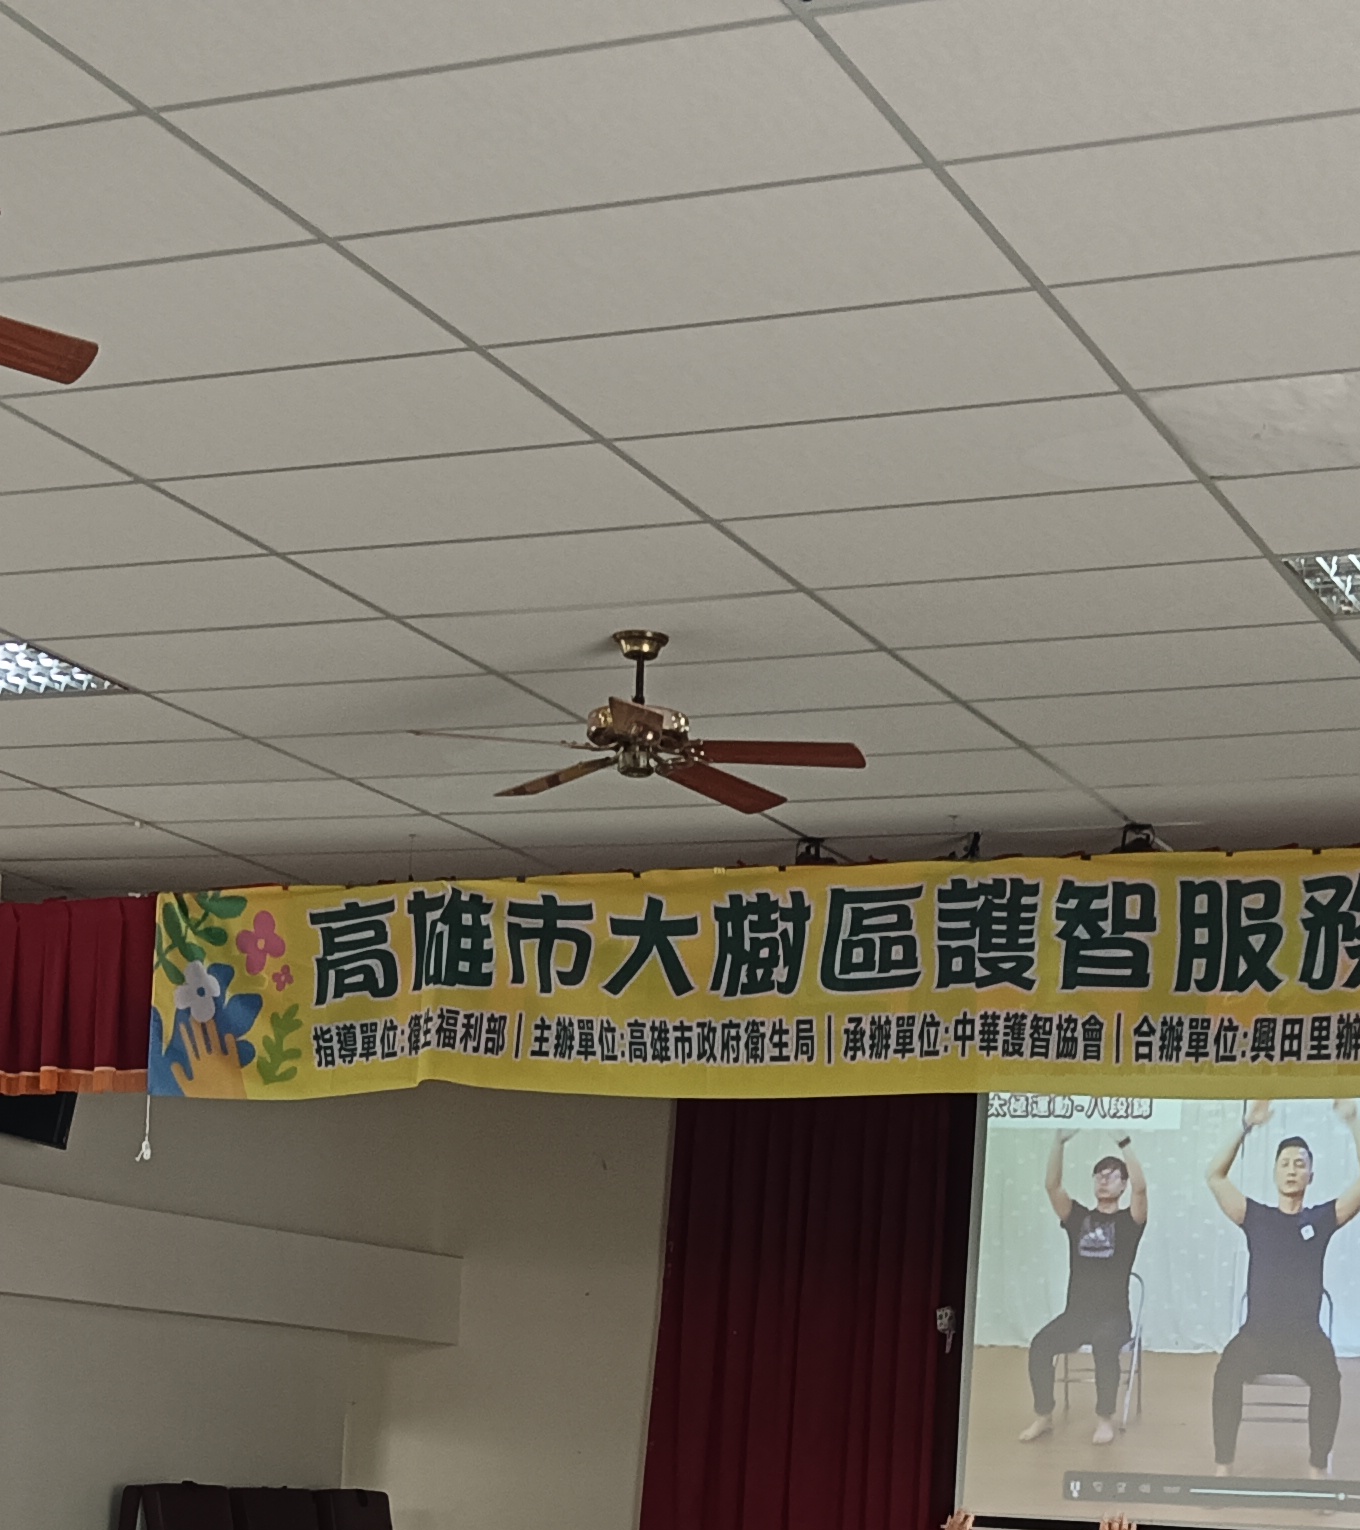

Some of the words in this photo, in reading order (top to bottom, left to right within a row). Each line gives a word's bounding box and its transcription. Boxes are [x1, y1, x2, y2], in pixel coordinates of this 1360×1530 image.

[312, 1007, 509, 1068] 指導單位:衛生福利部
[531, 1016, 815, 1065] 主辦單位:高雄市政府衛生局
[843, 1011, 1104, 1062] 承辦單位:中華護智協會
